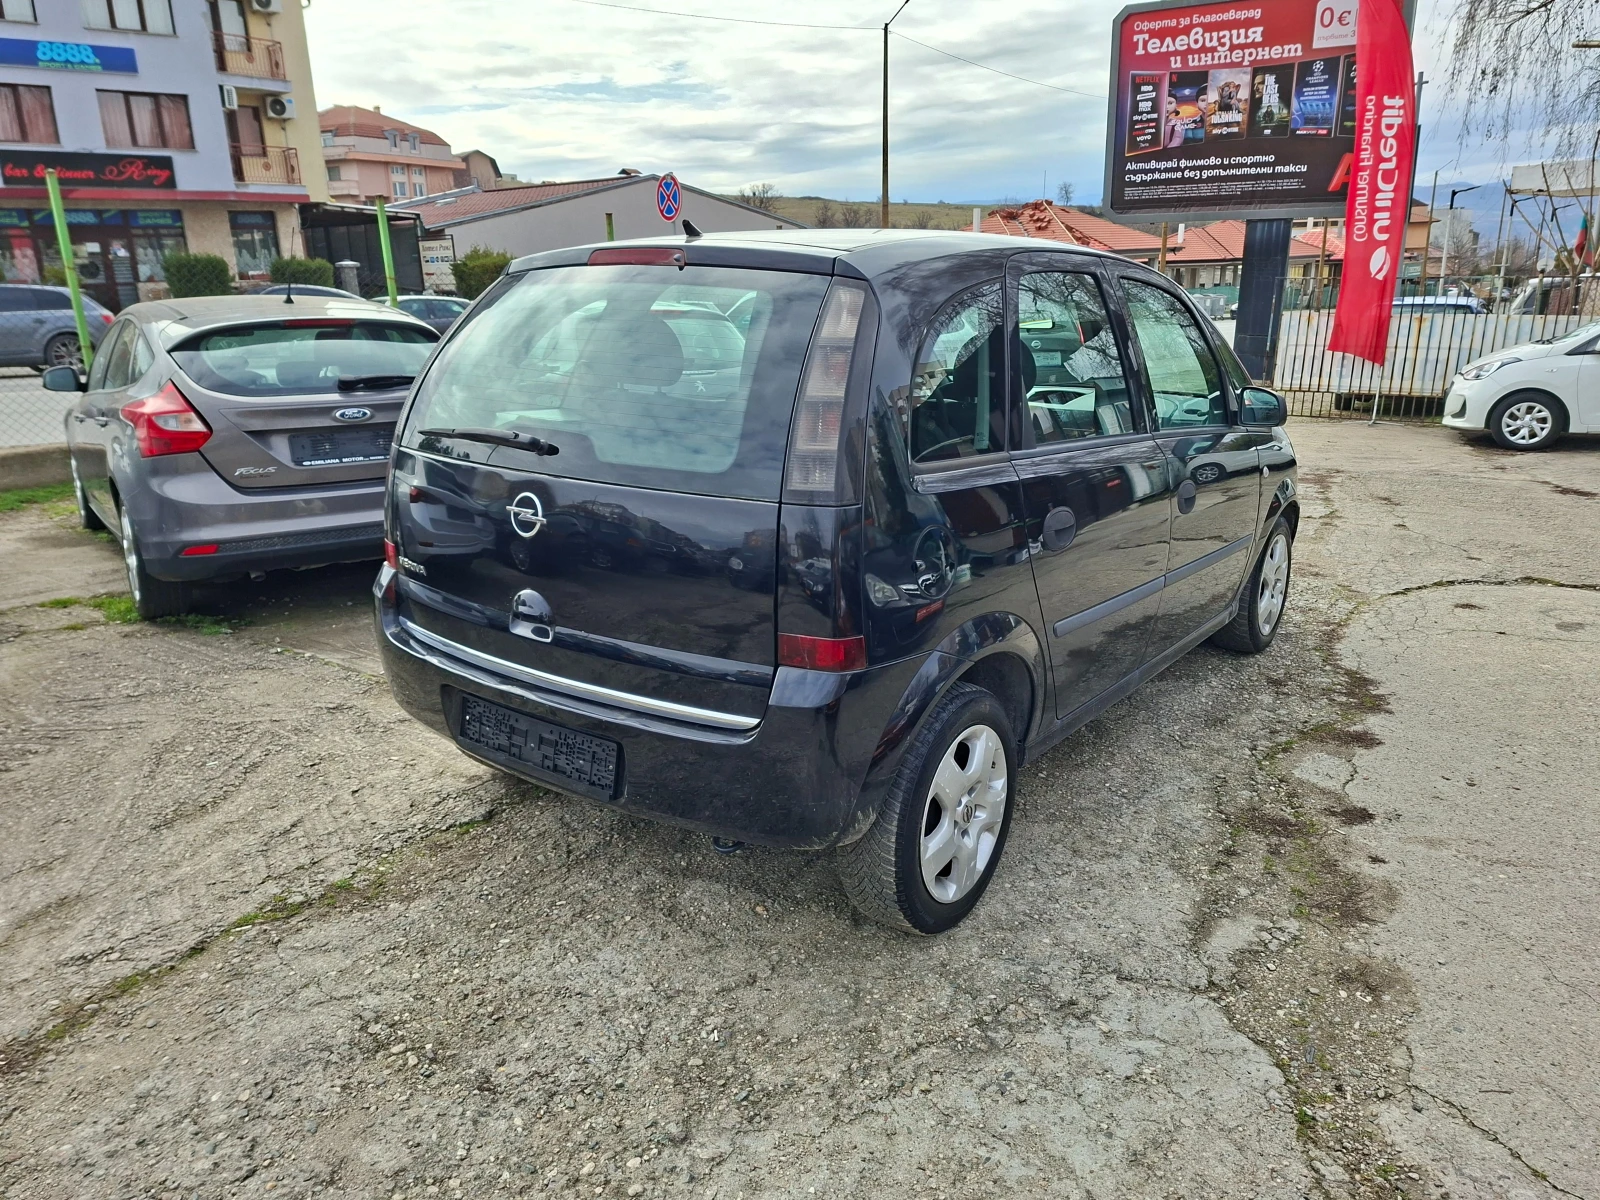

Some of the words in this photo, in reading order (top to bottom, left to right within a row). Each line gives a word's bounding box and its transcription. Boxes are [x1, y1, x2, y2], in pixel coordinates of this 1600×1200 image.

[1134, 19, 1177, 32] Оферта
[1179, 17, 1190, 28] за
[1193, 8, 1262, 24] Благоевград
[1320, 7, 1334, 28] 0
[1337, 10, 1351, 26] €
[1133, 27, 1263, 55] Телевизия
[1317, 33, 1348, 41] първите
[1170, 56, 1182, 68] и
[1188, 43, 1303, 66] интернет
[1135, 76, 1160, 84] NETFLIX
[1264, 74, 1276, 85] THE
[1263, 84, 1279, 94] LAST
[1262, 94, 1269, 104] OF
[1270, 93, 1279, 103] US
[1125, 159, 1178, 171] Активирай
[1179, 156, 1221, 169] филмово
[1230, 154, 1275, 166] спортно
[5, 163, 29, 177] bar
[99, 158, 171, 186] Ring
[1125, 171, 1182, 182] съдържание
[1184, 170, 1200, 180] без
[1201, 165, 1273, 179] допълнителни
[1274, 163, 1307, 173] такси
[344, 409, 363, 418] Ford
[311, 458, 340, 466] EMILIANA
